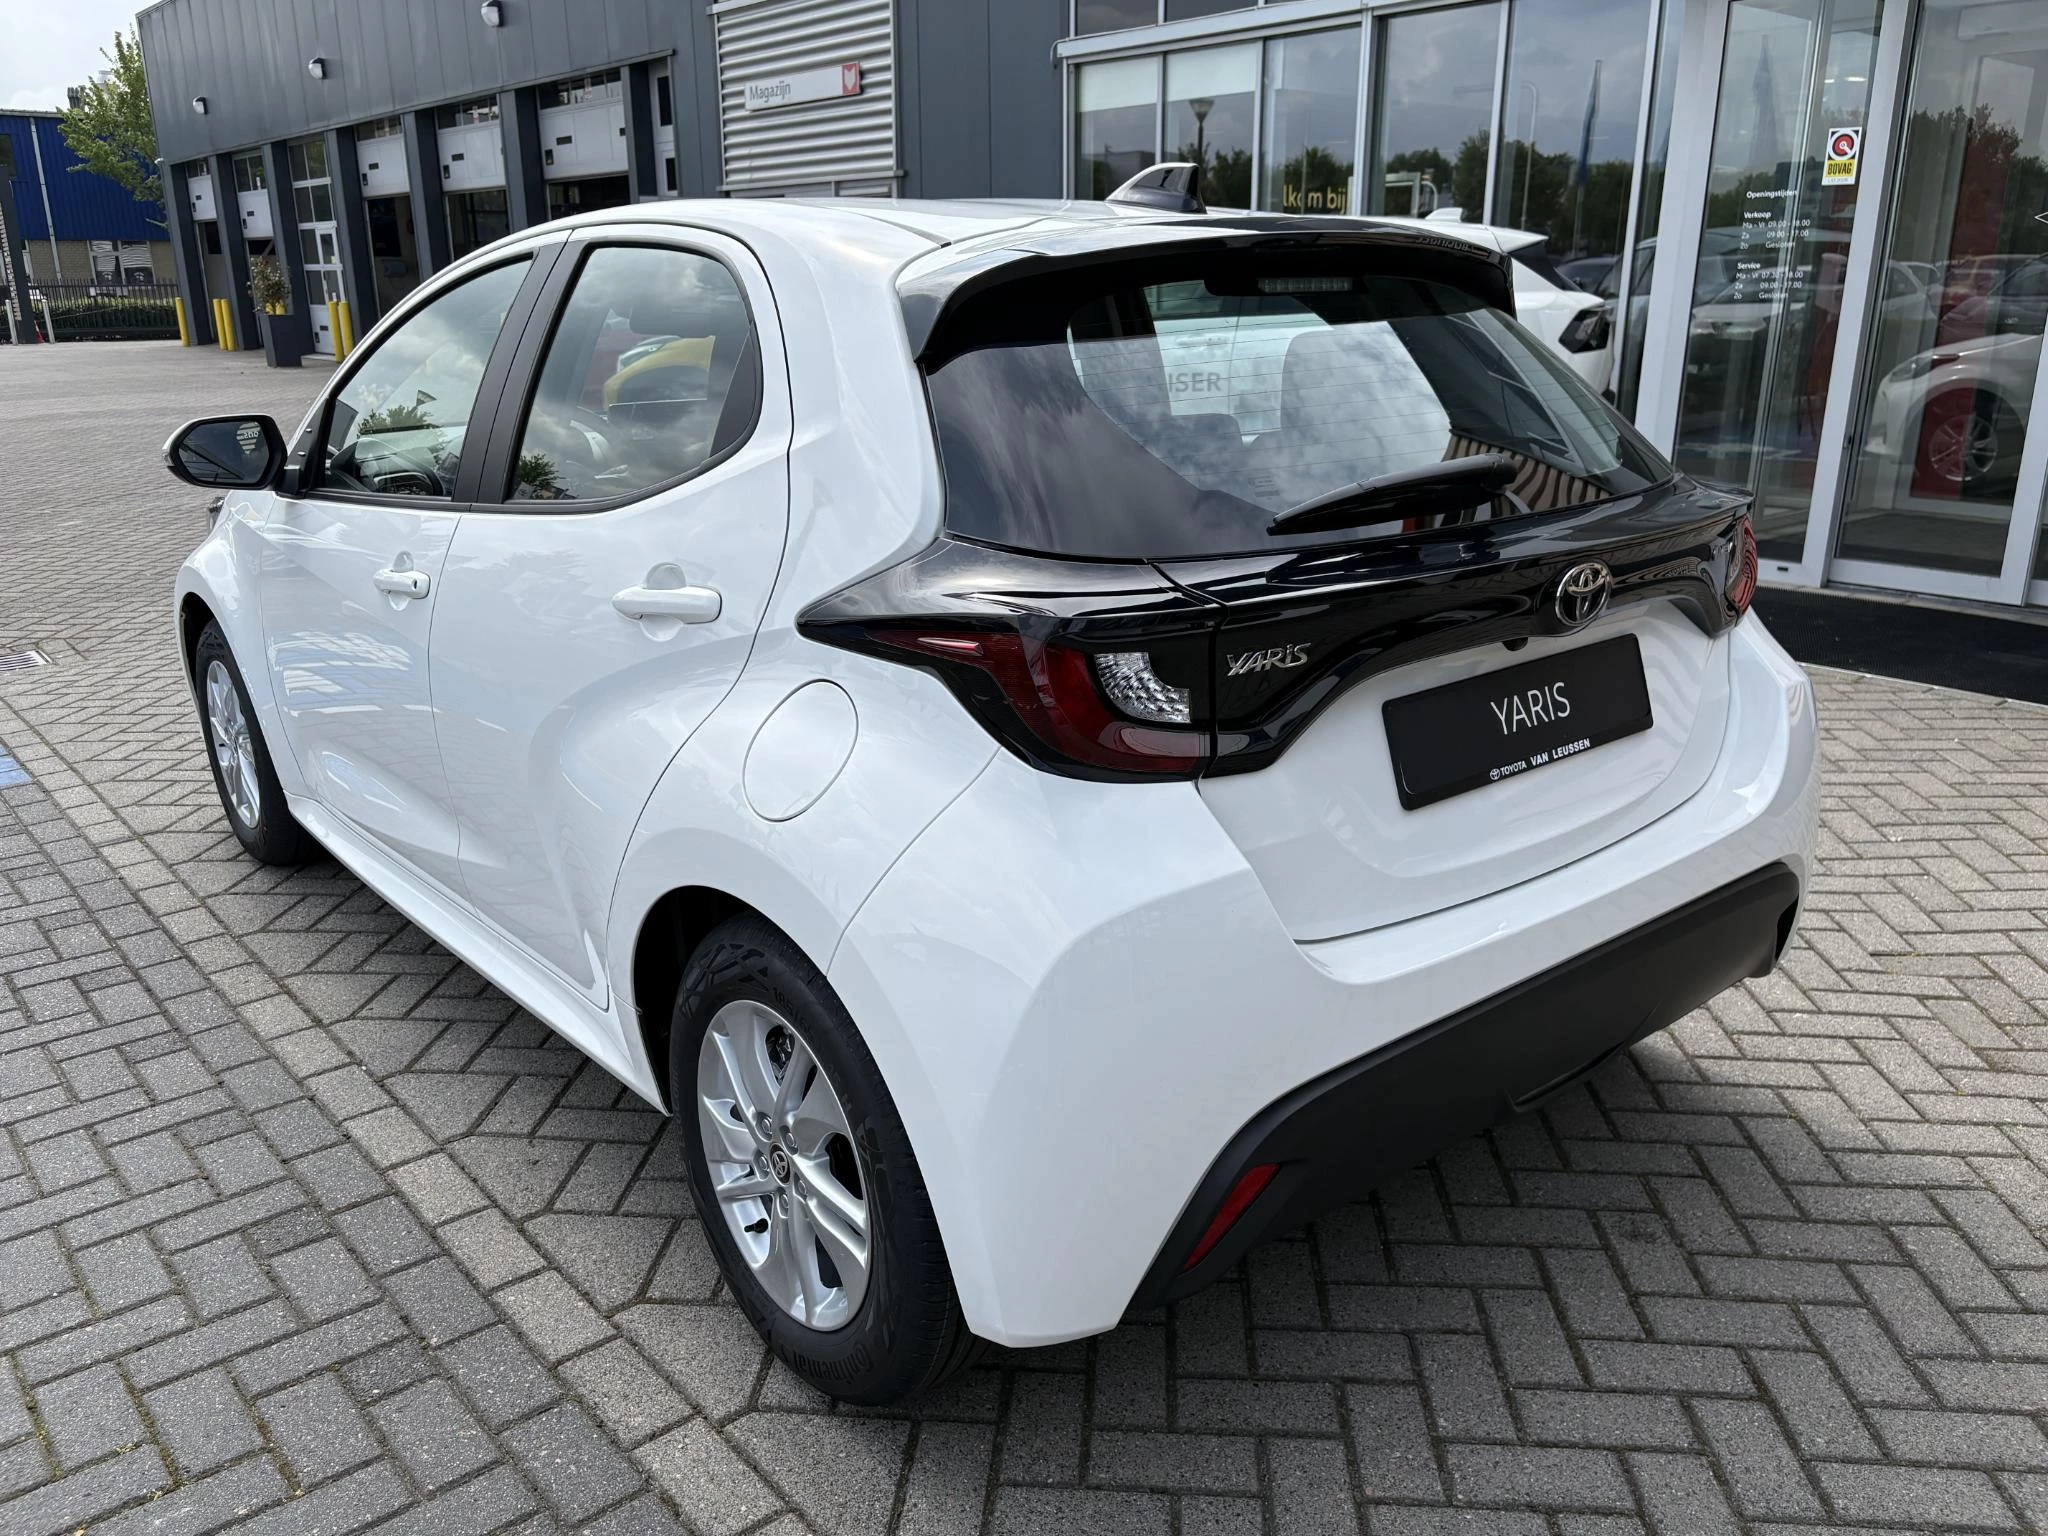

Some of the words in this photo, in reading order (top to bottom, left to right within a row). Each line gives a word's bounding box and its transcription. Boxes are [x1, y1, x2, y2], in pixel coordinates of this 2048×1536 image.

[749, 80, 791, 103] Magazijn
[1828, 162, 1853, 176] BOVAG
[1327, 186, 1346, 215] bij
[1746, 188, 1798, 200] Openingstijden
[1743, 211, 1772, 220] Verkoop
[1737, 262, 1761, 270] Service
[1490, 681, 1571, 736] YARIS
[1500, 760, 1528, 777] TOYOTA
[1530, 751, 1549, 767] VAN
[1552, 737, 1592, 760] LEUSSEN
